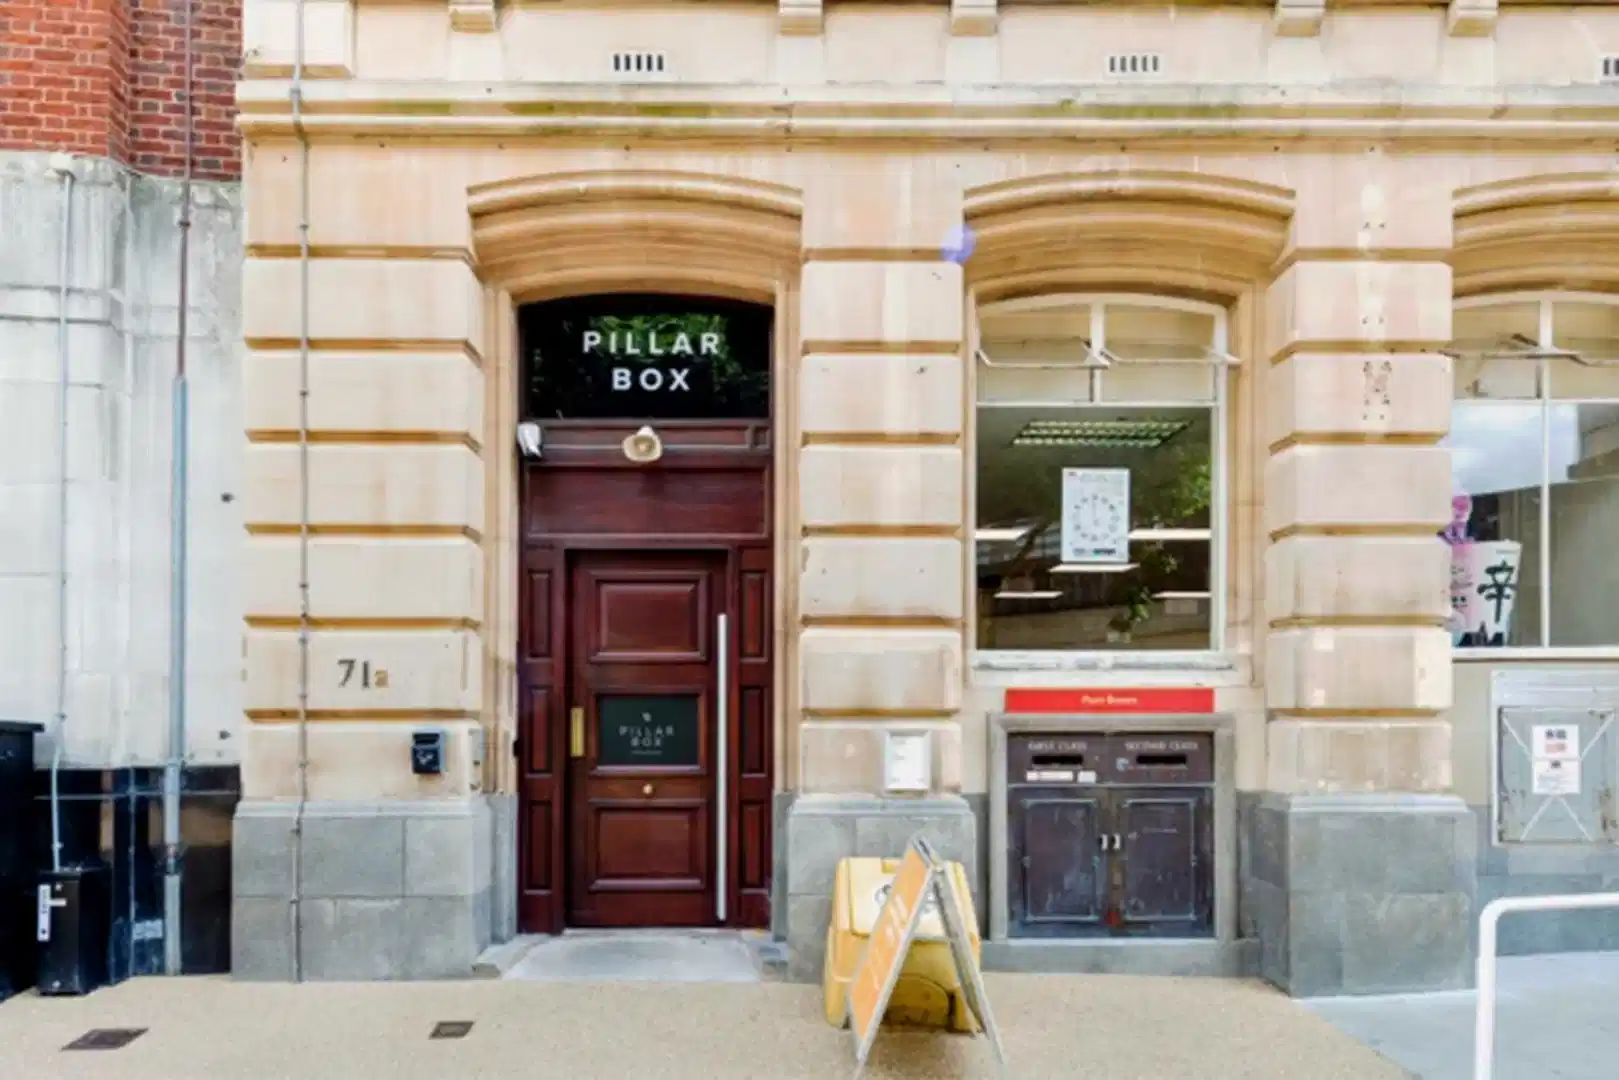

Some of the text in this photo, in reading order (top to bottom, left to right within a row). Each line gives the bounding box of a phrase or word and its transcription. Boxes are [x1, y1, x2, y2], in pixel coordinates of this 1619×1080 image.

[582, 330, 720, 355] PILLAR
[612, 367, 690, 392] BOX
[618, 725, 674, 736] PILLAR
[630, 736, 661, 747] BOX
